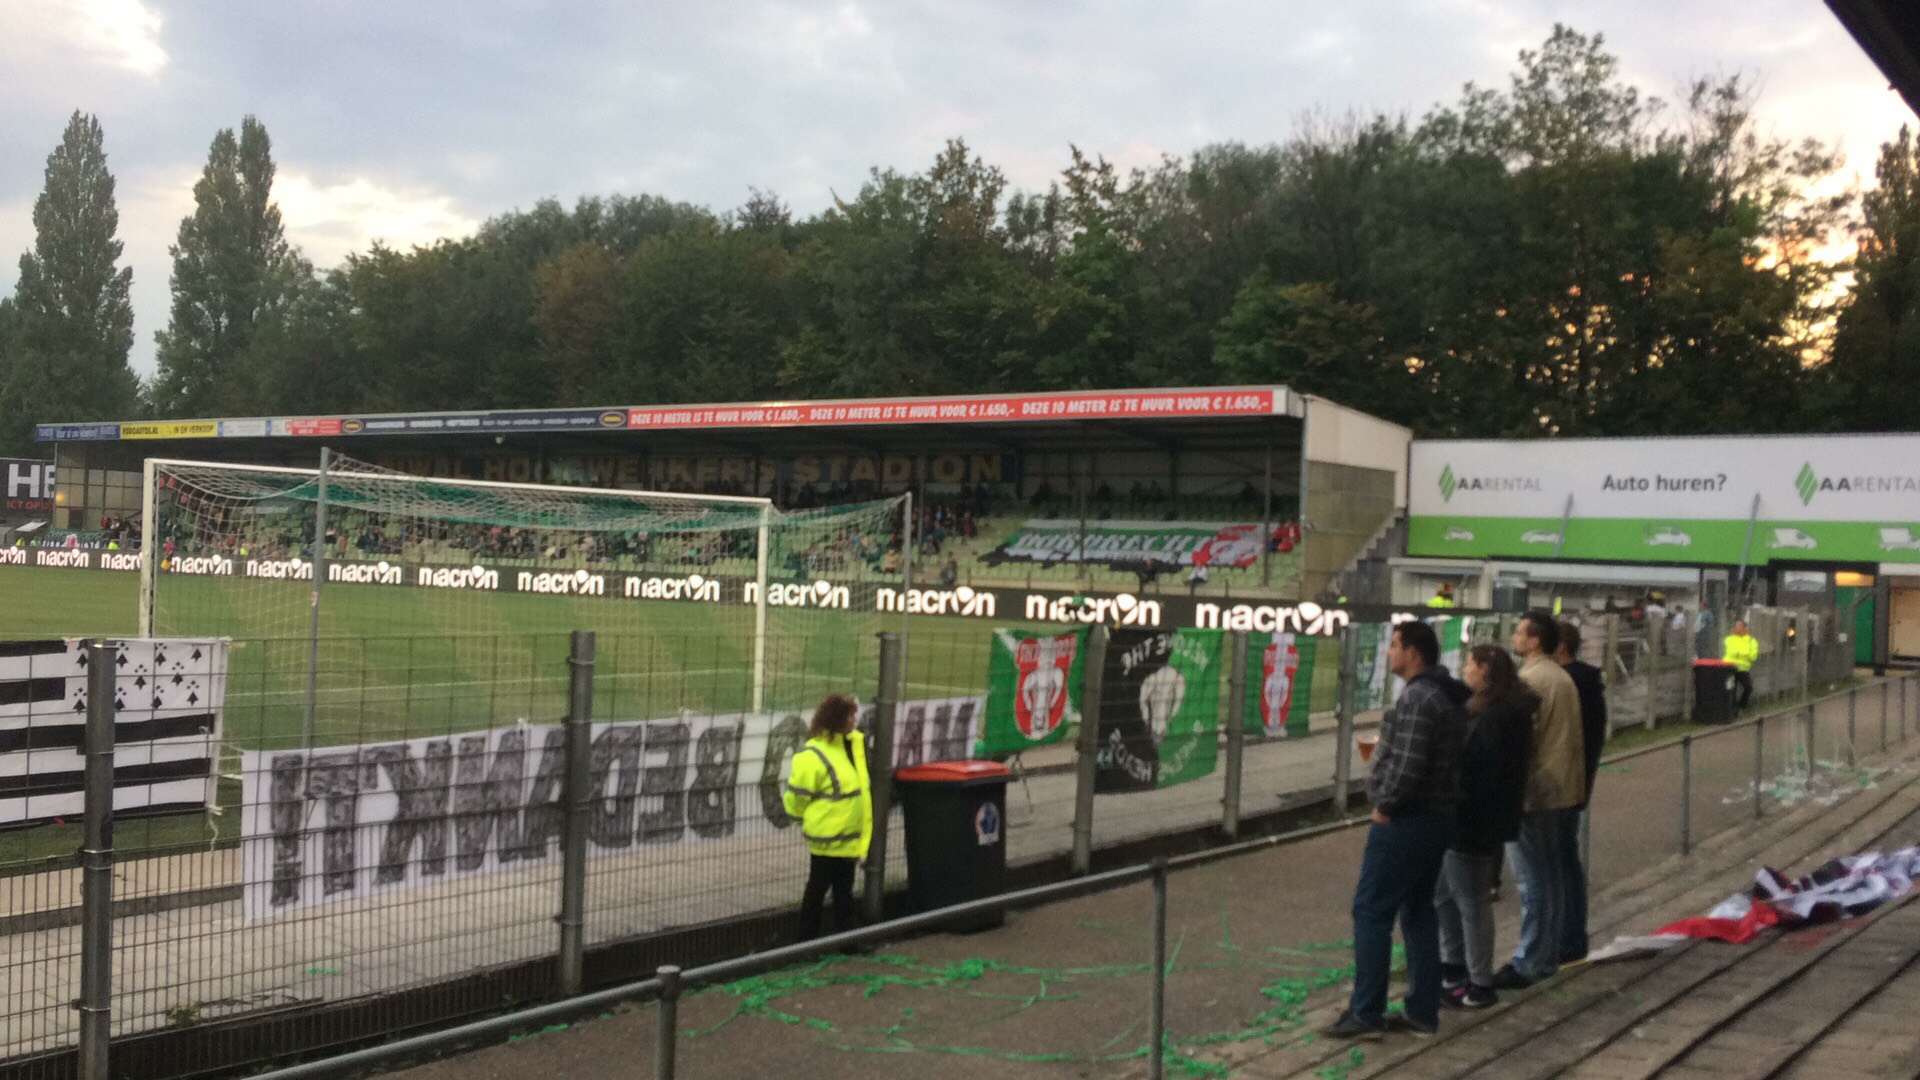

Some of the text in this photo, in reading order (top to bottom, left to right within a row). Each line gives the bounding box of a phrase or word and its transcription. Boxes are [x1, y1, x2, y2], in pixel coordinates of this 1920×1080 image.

[810, 408, 834, 420] DEZE
[836, 408, 846, 419] 10
[848, 407, 881, 419] METER
[883, 406, 894, 418] IS
[895, 406, 907, 418] TE
[910, 405, 938, 417] HUUR
[940, 404, 967, 417] VOOR
[1022, 401, 1050, 414] DEZE
[1052, 401, 1065, 414] 10
[1067, 400, 1107, 413] METER
[1109, 399, 1122, 412] IS
[1124, 398, 1139, 411] TE
[1141, 397, 1174, 411] HUUR
[1177, 397, 1211, 410] VOOR
[632, 413, 652, 425] DEZE
[653, 412, 662, 424] 10
[663, 411, 693, 424] METER
[693, 411, 702, 423] IS
[704, 410, 714, 422] TE
[716, 410, 740, 423] HUUR
[741, 410, 765, 422] VOOR
[1458, 477, 1543, 491] AARENTAL
[1602, 474, 1728, 491] Auto huren?
[1820, 476, 1920, 491] AARENTA
[37, 549, 89, 567] macron
[101, 552, 142, 571] macr
[171, 554, 233, 576] macron
[246, 558, 314, 580] macron
[329, 561, 402, 585] macron
[418, 565, 499, 590] macron
[517, 569, 604, 596] macron
[624, 574, 721, 602] macron
[743, 579, 850, 609] macron
[876, 585, 996, 618] macron
[1025, 593, 1161, 626] macron
[1195, 601, 1350, 636] macron
